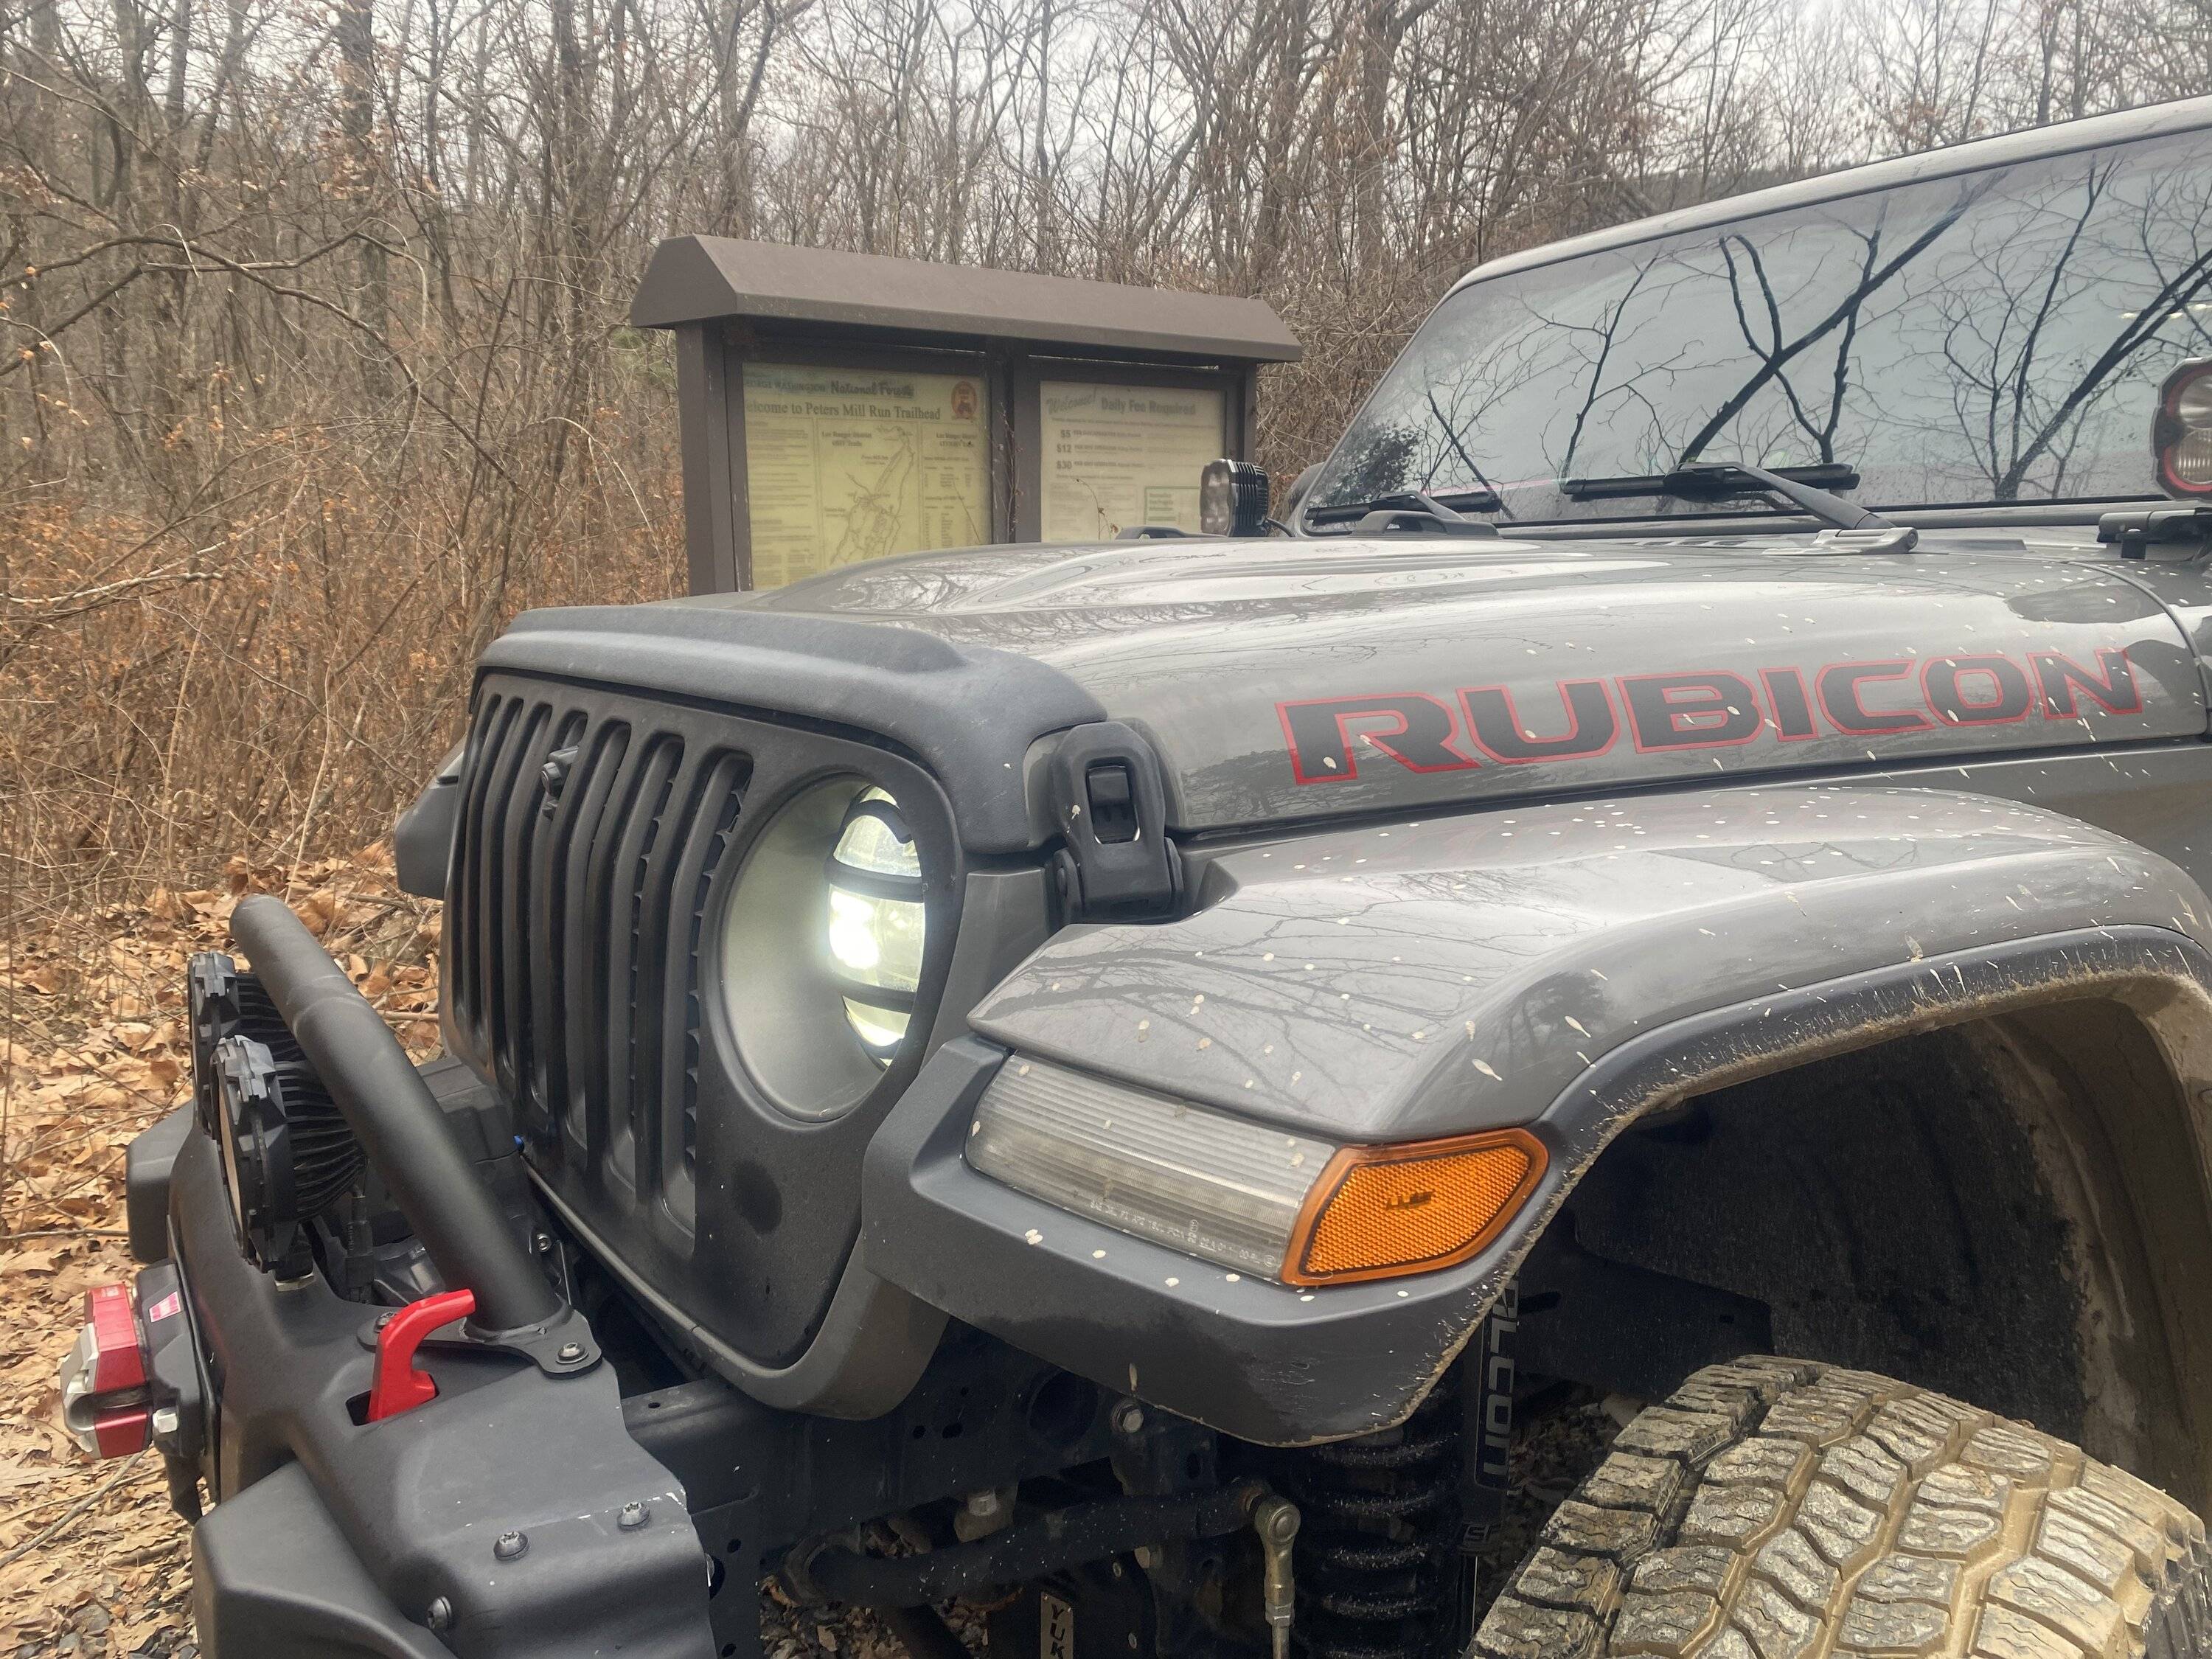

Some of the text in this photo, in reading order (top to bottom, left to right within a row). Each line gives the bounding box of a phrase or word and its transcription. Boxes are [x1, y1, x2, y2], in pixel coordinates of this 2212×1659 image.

[831, 380, 877, 394] National
[791, 403, 802, 414] to
[804, 402, 839, 416] Peters
[842, 403, 866, 417] Mill
[869, 405, 891, 417] Run
[893, 406, 941, 420] Trailhead
[1102, 397, 1196, 416] Daily Fee Required
[1056, 444, 1072, 453] $12
[1056, 461, 1073, 470] $30
[1275, 648, 2143, 786] RUBICON
[1483, 1279, 1519, 1475] ALCON
